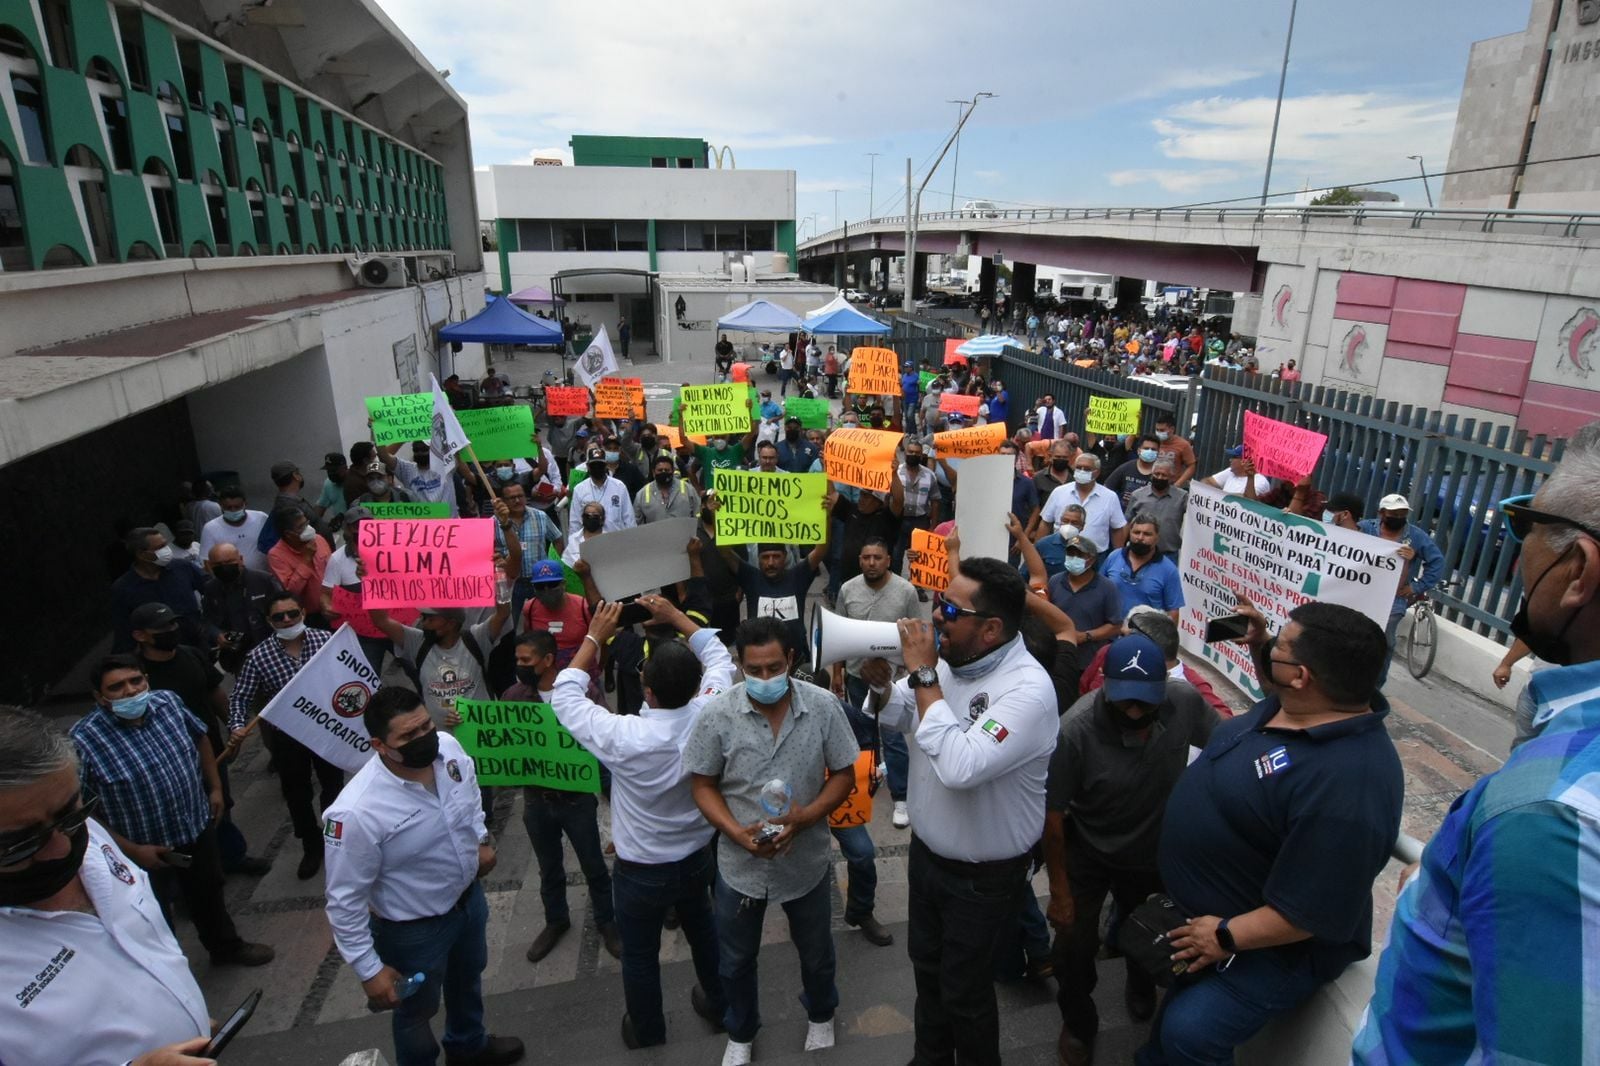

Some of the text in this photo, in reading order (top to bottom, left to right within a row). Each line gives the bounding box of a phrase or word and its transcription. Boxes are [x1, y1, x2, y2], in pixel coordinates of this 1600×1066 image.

[873, 364, 896, 380] PARA
[382, 394, 427, 407] IMSS
[684, 387, 734, 402] QUEREMOS
[373, 402, 435, 419] QUEREMO
[691, 404, 732, 416] MEDICOS
[376, 426, 432, 442] NO PROME
[684, 416, 749, 432] ESPECIALISTAS
[825, 440, 866, 466] MEDICOS
[952, 438, 989, 447] HECHOS
[953, 446, 1000, 454] PROMESA
[716, 473, 802, 499] QUEREMOS
[716, 495, 788, 520] MEDICOS
[362, 521, 460, 548] SE EXIGE
[717, 518, 821, 541] ESPECIALISTAS
[1213, 501, 1237, 520] PASÓ
[1240, 511, 1261, 529] CON
[1264, 520, 1284, 538] LAS
[1286, 529, 1397, 571] AMPLIACIONES
[1196, 511, 1372, 585] QUE PROMETIERON PARA TODO
[375, 551, 452, 576] CLIMA
[914, 550, 949, 575] BASTO
[1190, 558, 1201, 571] DE
[1203, 565, 1218, 581] LOS
[1231, 545, 1303, 585] EL HOSPITAL?
[362, 577, 399, 602] PARA
[402, 579, 426, 601] LOS
[910, 568, 949, 590] MEDICA
[1203, 598, 1208, 609] A
[1264, 578, 1283, 596] LAS
[1286, 588, 1317, 606] PRO
[1191, 607, 1203, 621] NO
[1181, 619, 1196, 636] LAS
[292, 696, 371, 752] DEMOCRATICO
[455, 701, 544, 725] EXIGIMOS
[476, 727, 547, 749] ABASTO
[15, 981, 38, 1001] Carlos
[35, 963, 55, 981] Garza
